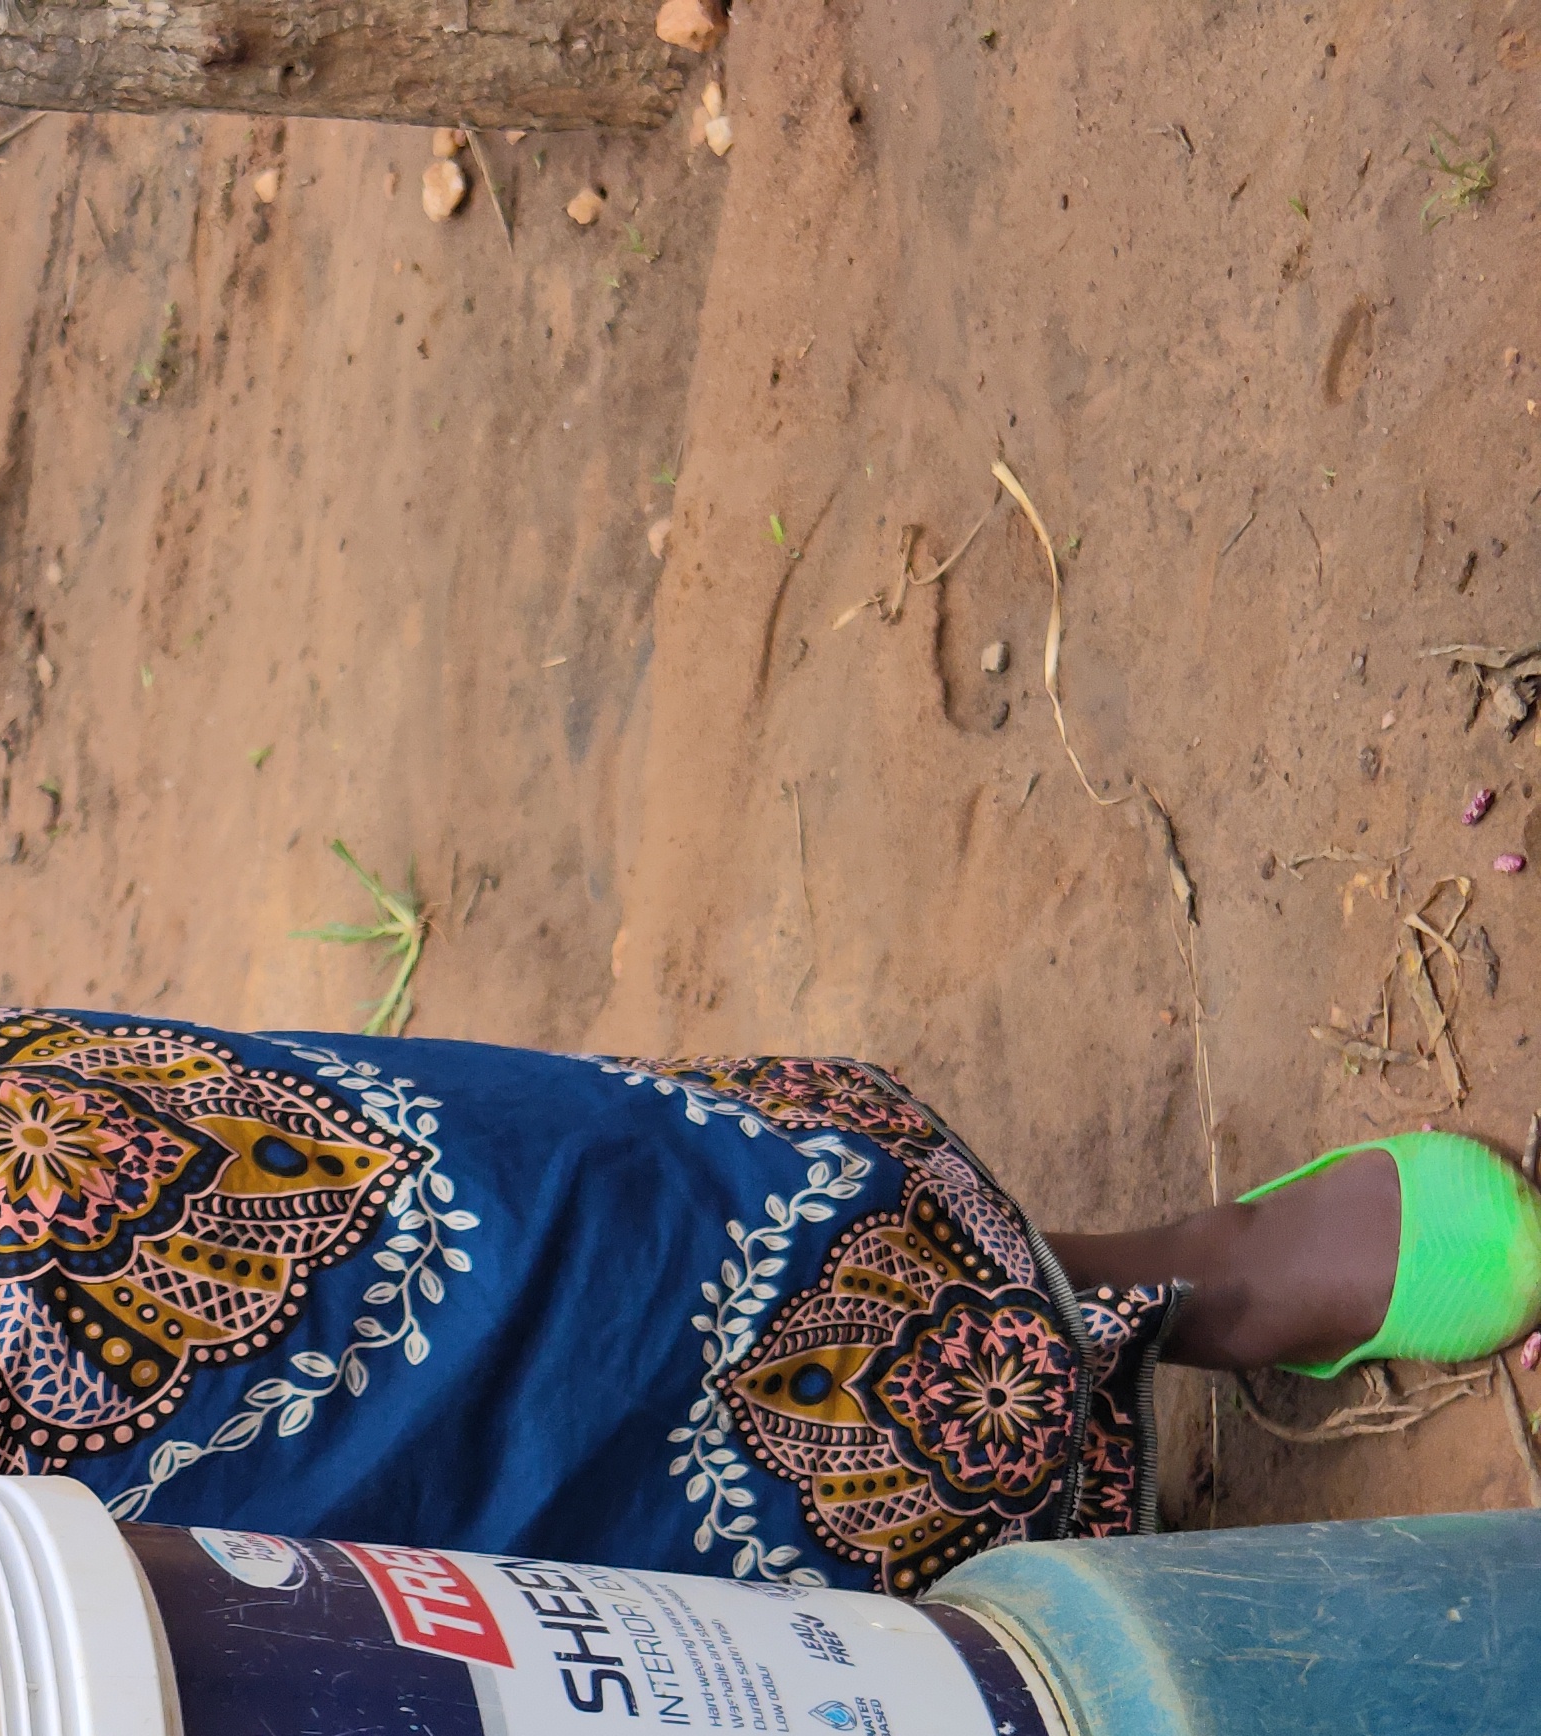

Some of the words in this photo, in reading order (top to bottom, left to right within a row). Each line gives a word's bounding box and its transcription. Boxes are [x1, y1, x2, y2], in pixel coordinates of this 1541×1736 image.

[222, 1541, 254, 1561] Top
[652, 1596, 666, 1604] or
[475, 1555, 639, 1717] SHEEN
[658, 1604, 688, 1638] interior
[686, 1615, 710, 1638] stain
[711, 1618, 733, 1644] finish
[700, 1639, 720, 1661] and
[789, 1621, 830, 1661] LEAD
[819, 1629, 856, 1667] FREE
[726, 1647, 749, 1675] satin
[680, 1639, 723, 1727] Hard-wearing
[714, 1663, 745, 1729] Washable
[755, 1663, 779, 1701] odour
[740, 1677, 768, 1730] Durable
[771, 1704, 789, 1733] Low
